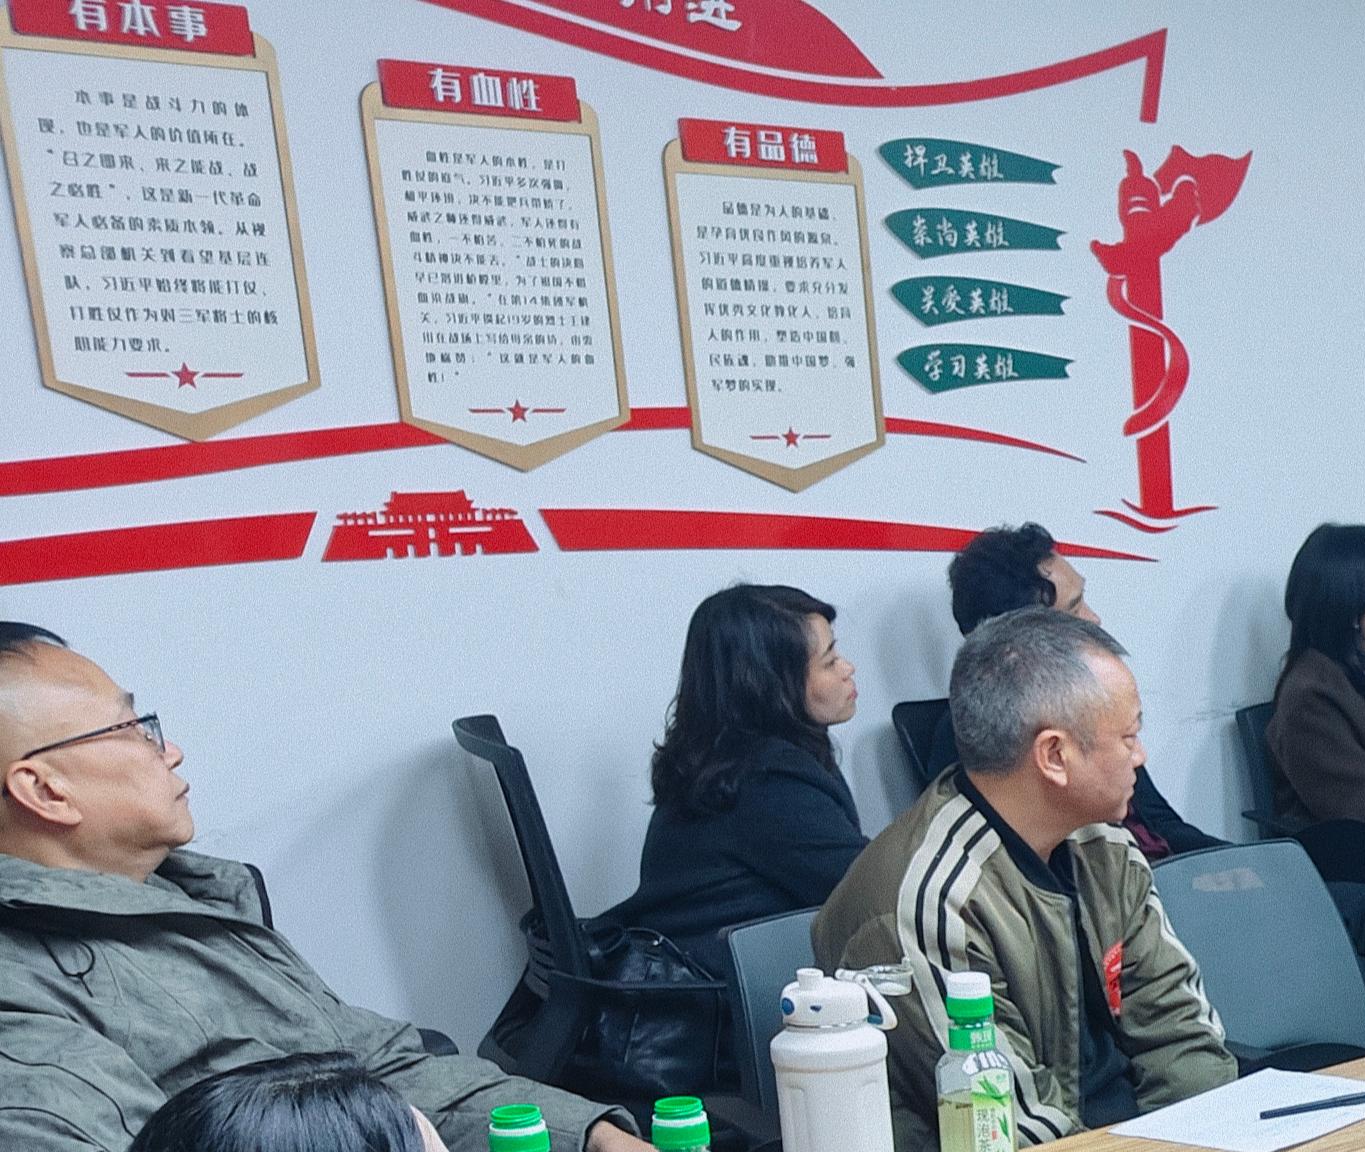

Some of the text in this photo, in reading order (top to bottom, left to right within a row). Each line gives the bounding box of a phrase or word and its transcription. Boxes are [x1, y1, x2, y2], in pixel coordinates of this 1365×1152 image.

[68, 0, 208, 42] 有本事
[428, 68, 543, 112] 有血性
[722, 126, 819, 164] 有品德
[903, 143, 1004, 180] 捍卫英雄
[912, 215, 1010, 247] 崇尚英雄
[700, 252, 848, 271] 习近平高度重视培养军人
[921, 285, 1014, 316] 关爱英雄
[924, 350, 1019, 381] 学习英雄
